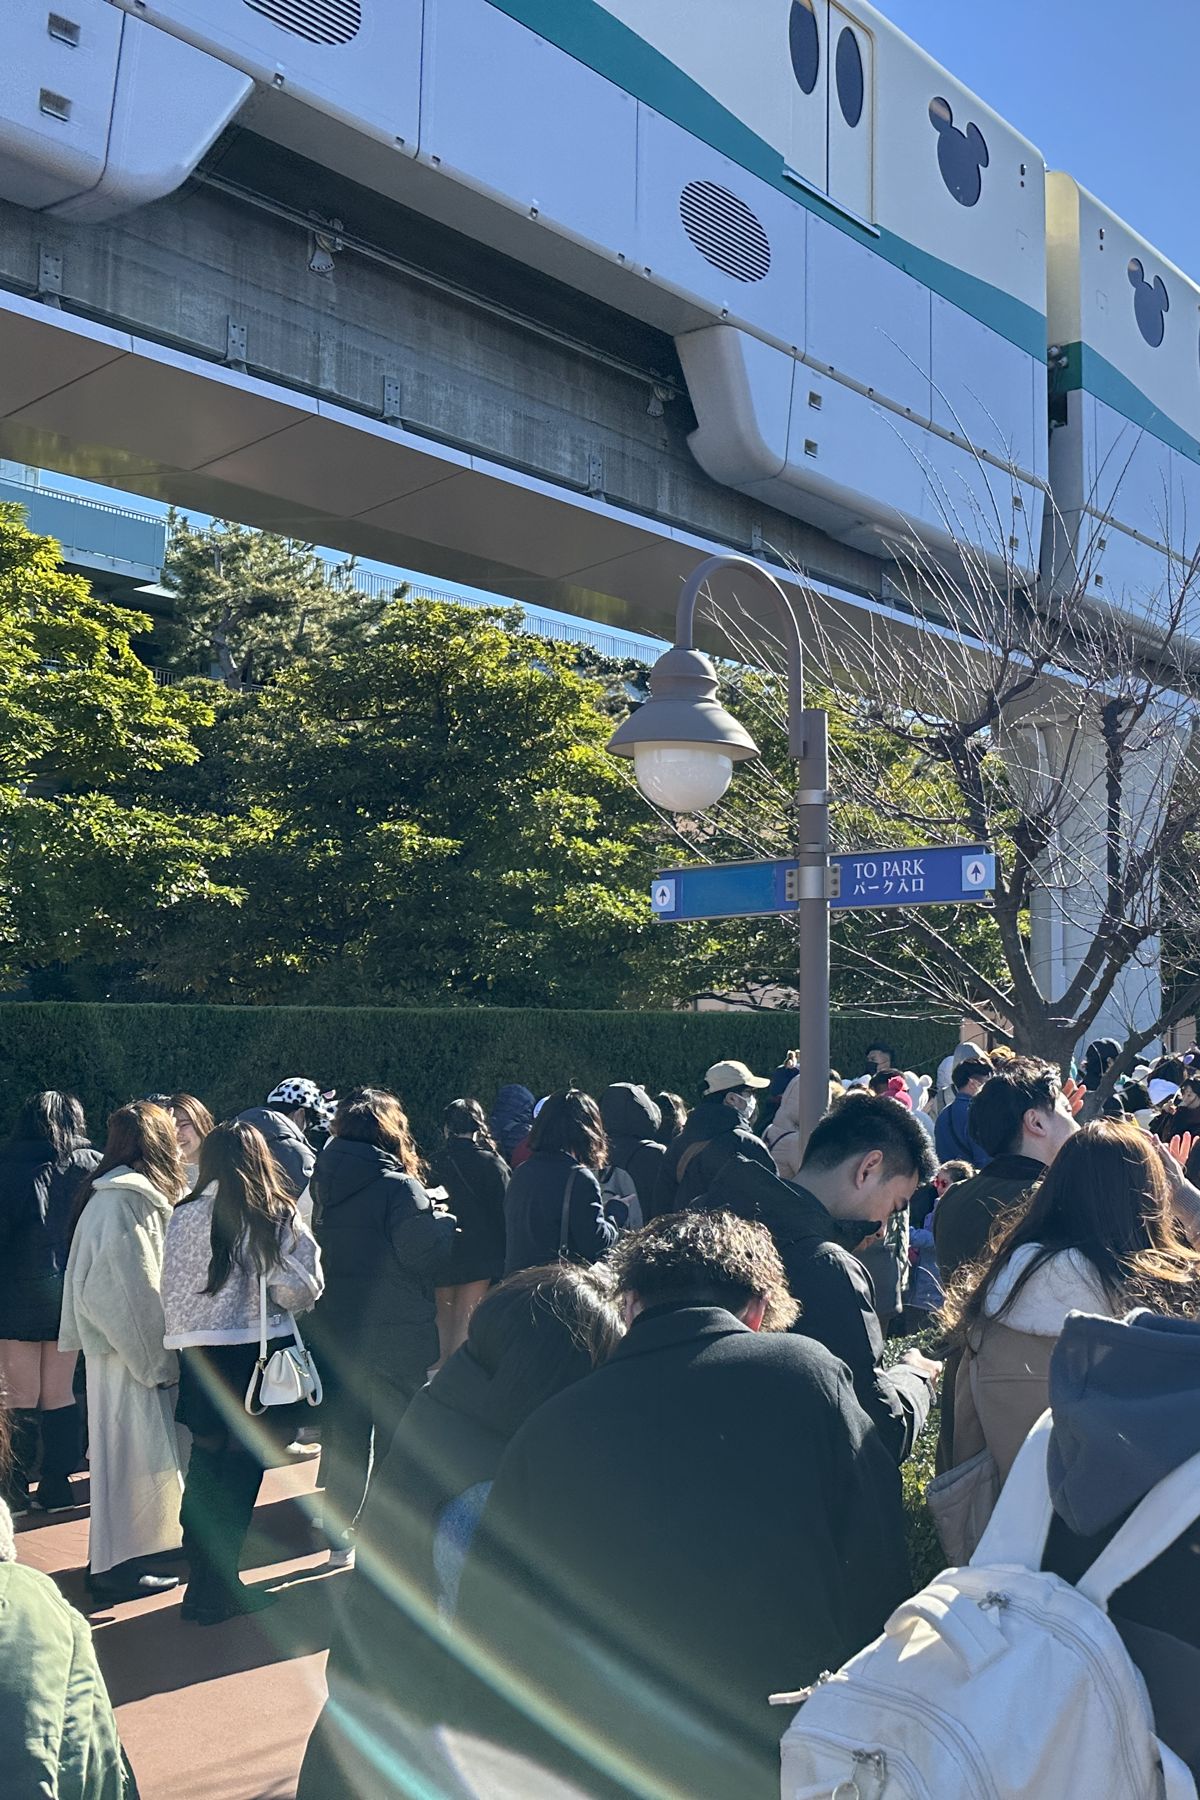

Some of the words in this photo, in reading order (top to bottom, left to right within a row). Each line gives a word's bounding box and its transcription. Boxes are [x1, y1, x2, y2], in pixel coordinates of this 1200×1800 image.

[853, 862, 877, 879] TO
[882, 859, 926, 878] PARK
[853, 878, 924, 895] パーク入口
